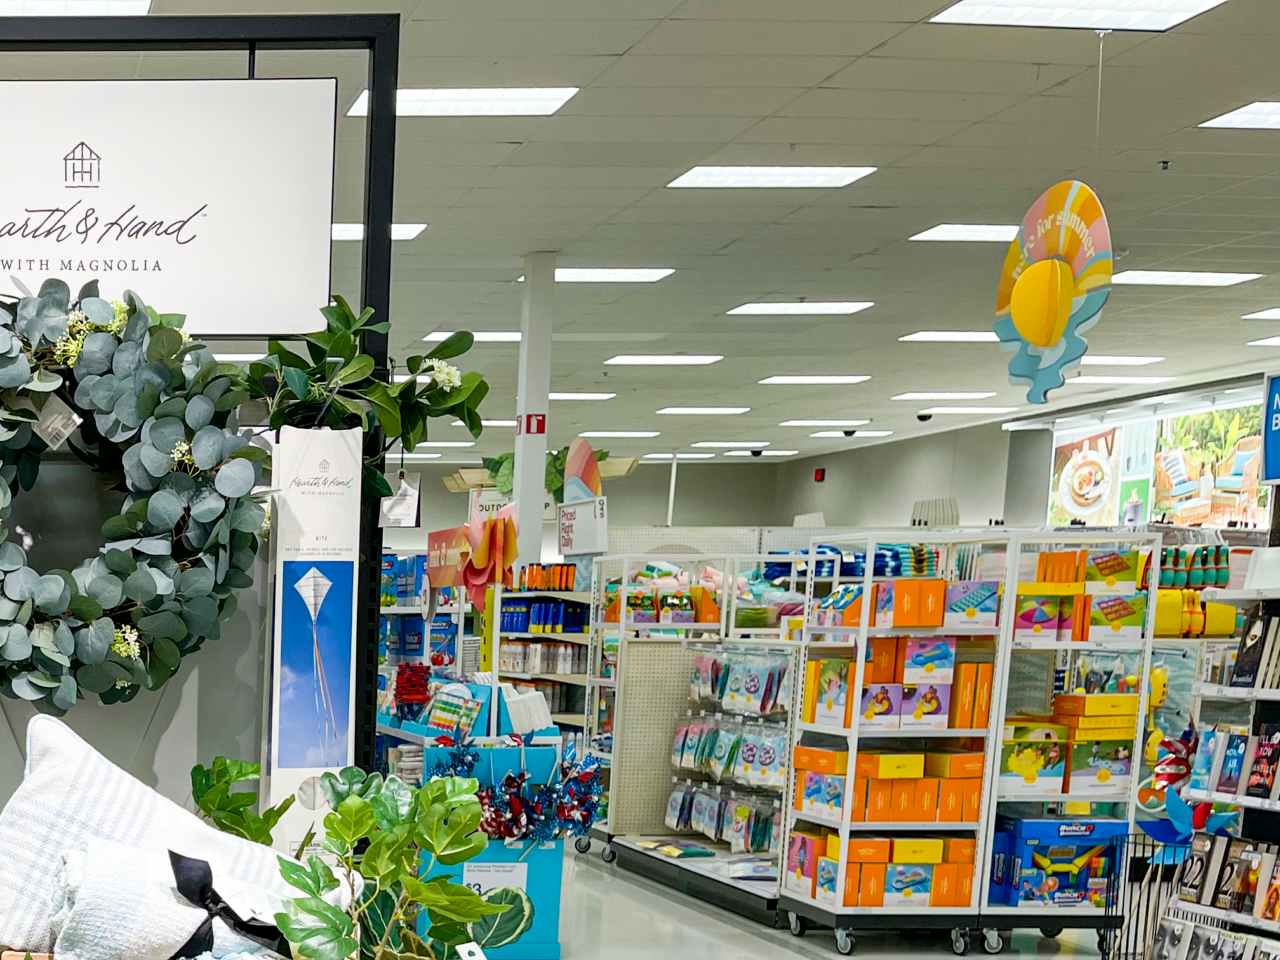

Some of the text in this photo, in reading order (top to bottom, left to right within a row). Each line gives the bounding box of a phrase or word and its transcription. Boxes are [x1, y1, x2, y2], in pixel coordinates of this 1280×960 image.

[76, 206, 100, 245] &
[96, 203, 209, 246] Hand
[0, 258, 162, 272] WITH MAGNOLIA
